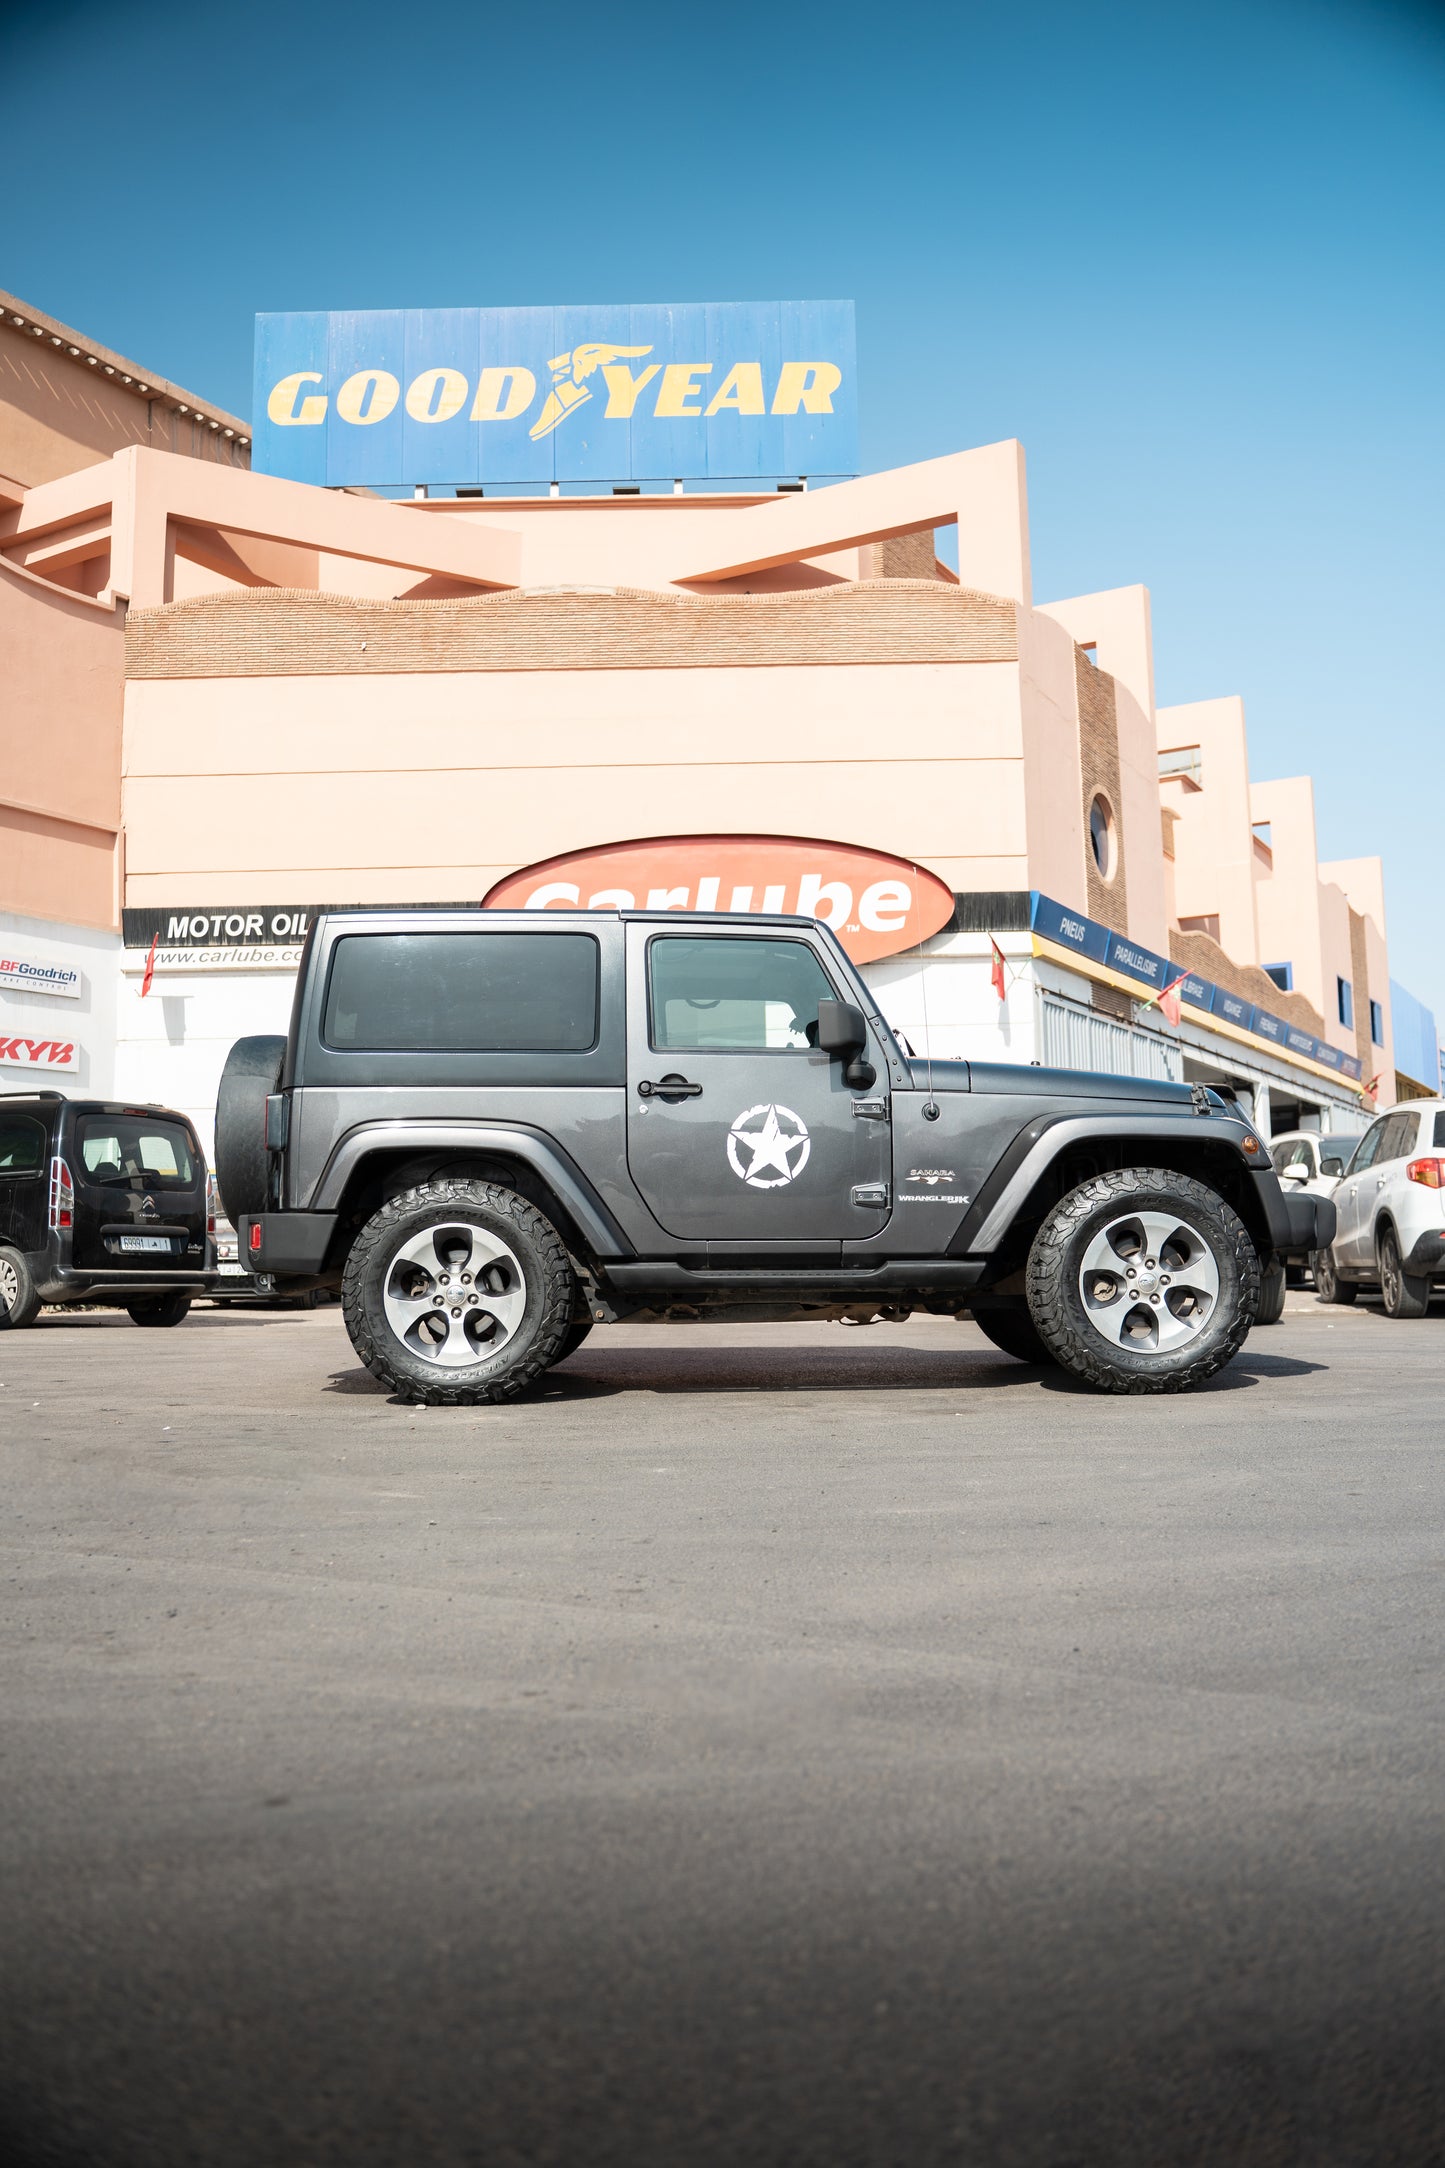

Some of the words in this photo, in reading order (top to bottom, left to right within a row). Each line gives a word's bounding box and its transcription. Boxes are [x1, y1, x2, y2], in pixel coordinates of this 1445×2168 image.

[167, 914, 265, 939] MOTOR
[271, 913, 308, 936] OIL
[1060, 917, 1085, 942] PNEUS
[0, 959, 77, 982] BFGoodrich
[0, 1037, 74, 1064] KYB
